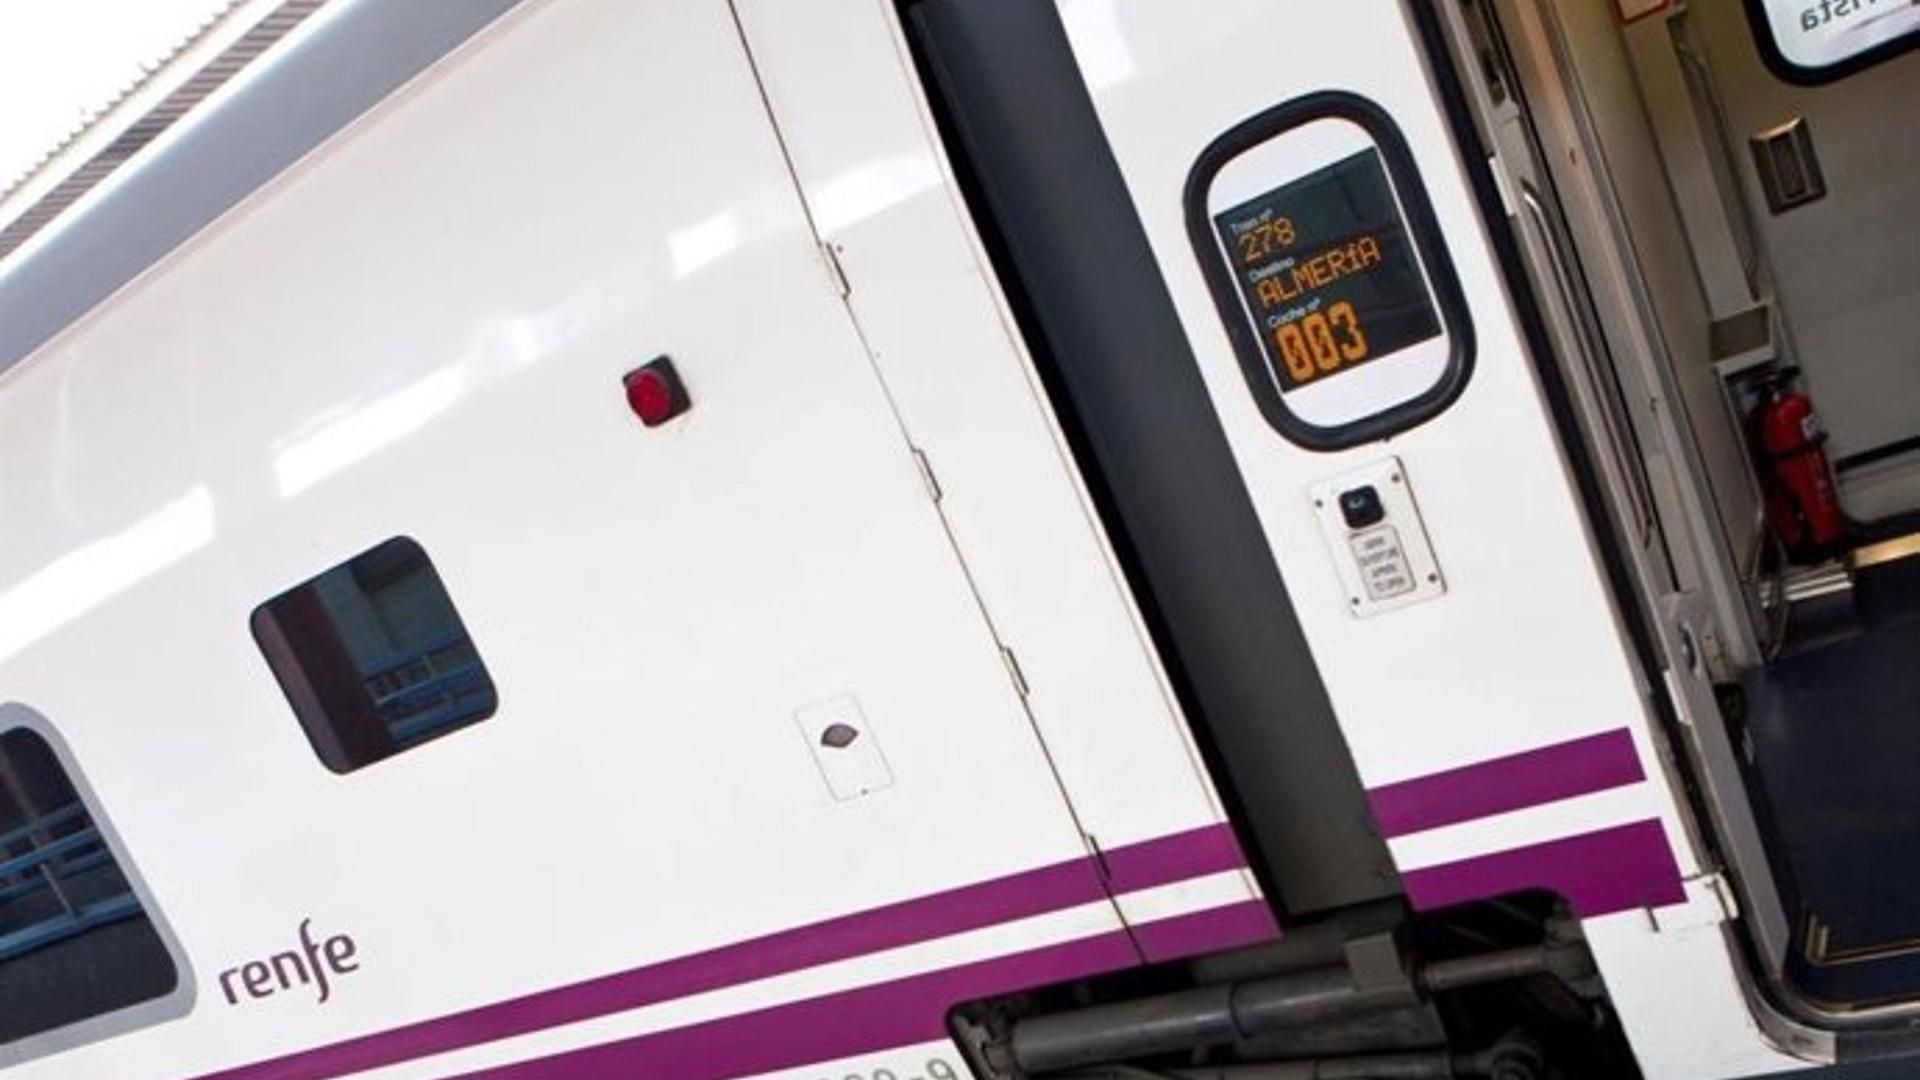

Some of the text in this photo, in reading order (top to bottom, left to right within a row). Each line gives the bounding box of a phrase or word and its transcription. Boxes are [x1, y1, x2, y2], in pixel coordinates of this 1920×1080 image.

[1238, 218, 1295, 262] 278
[1275, 301, 1368, 382] 003
[219, 917, 359, 1004] renfe
